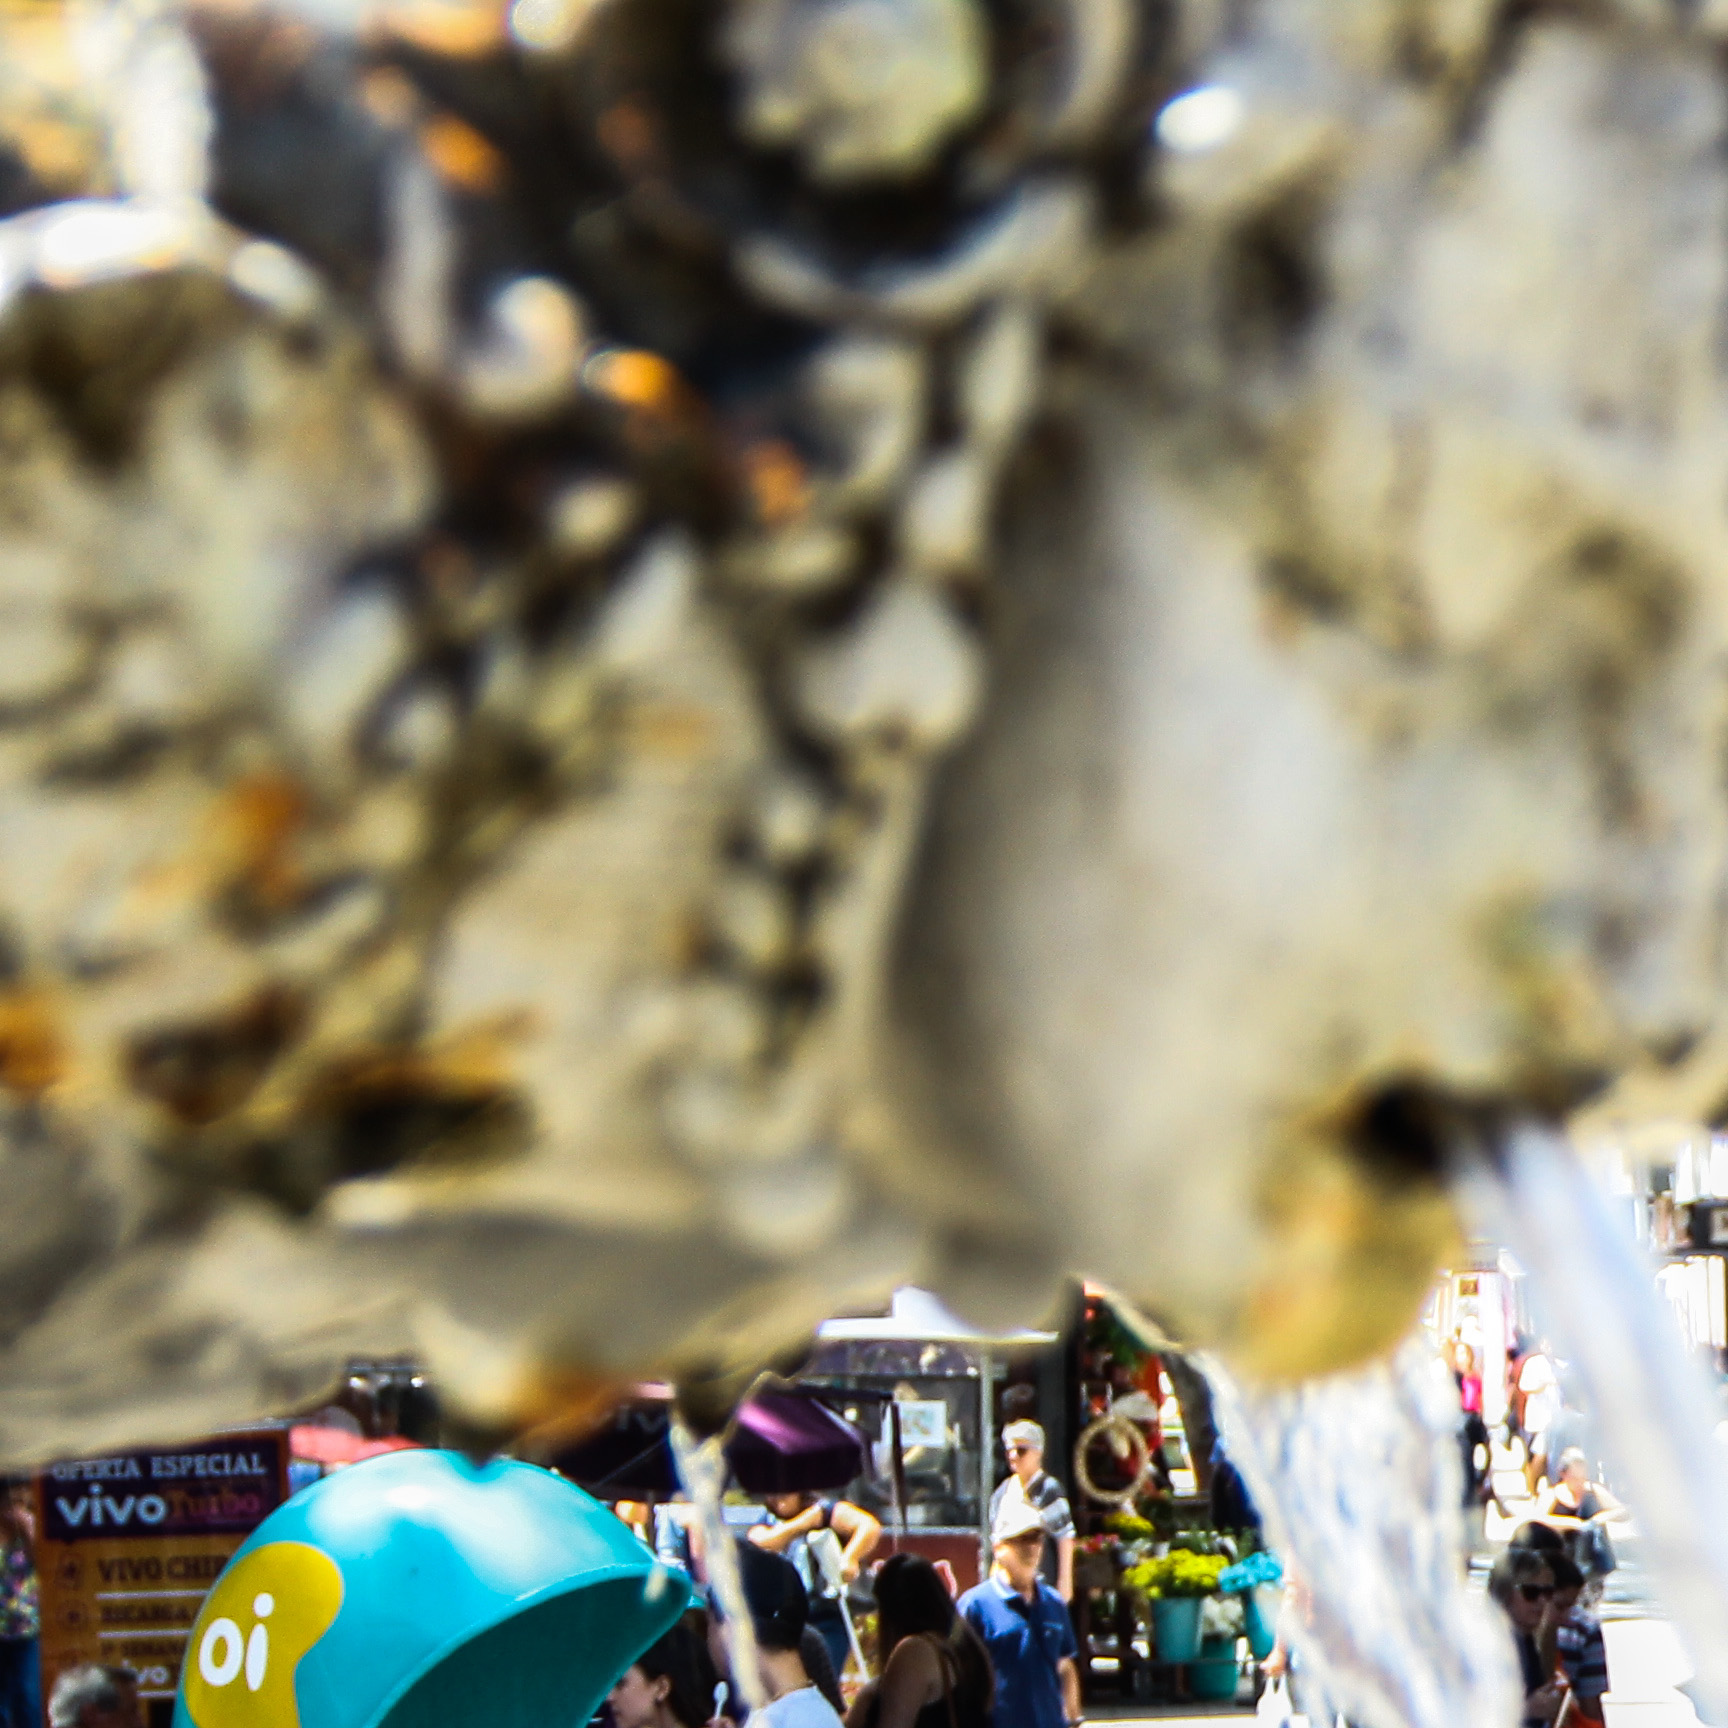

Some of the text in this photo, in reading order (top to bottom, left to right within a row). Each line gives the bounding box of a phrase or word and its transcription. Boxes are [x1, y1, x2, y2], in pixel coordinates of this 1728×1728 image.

[150, 1453, 267, 1479] ESPECIAL
[55, 1482, 167, 1526] vivo
[97, 1556, 162, 1581] VIVO
[198, 1592, 275, 1692] oi
